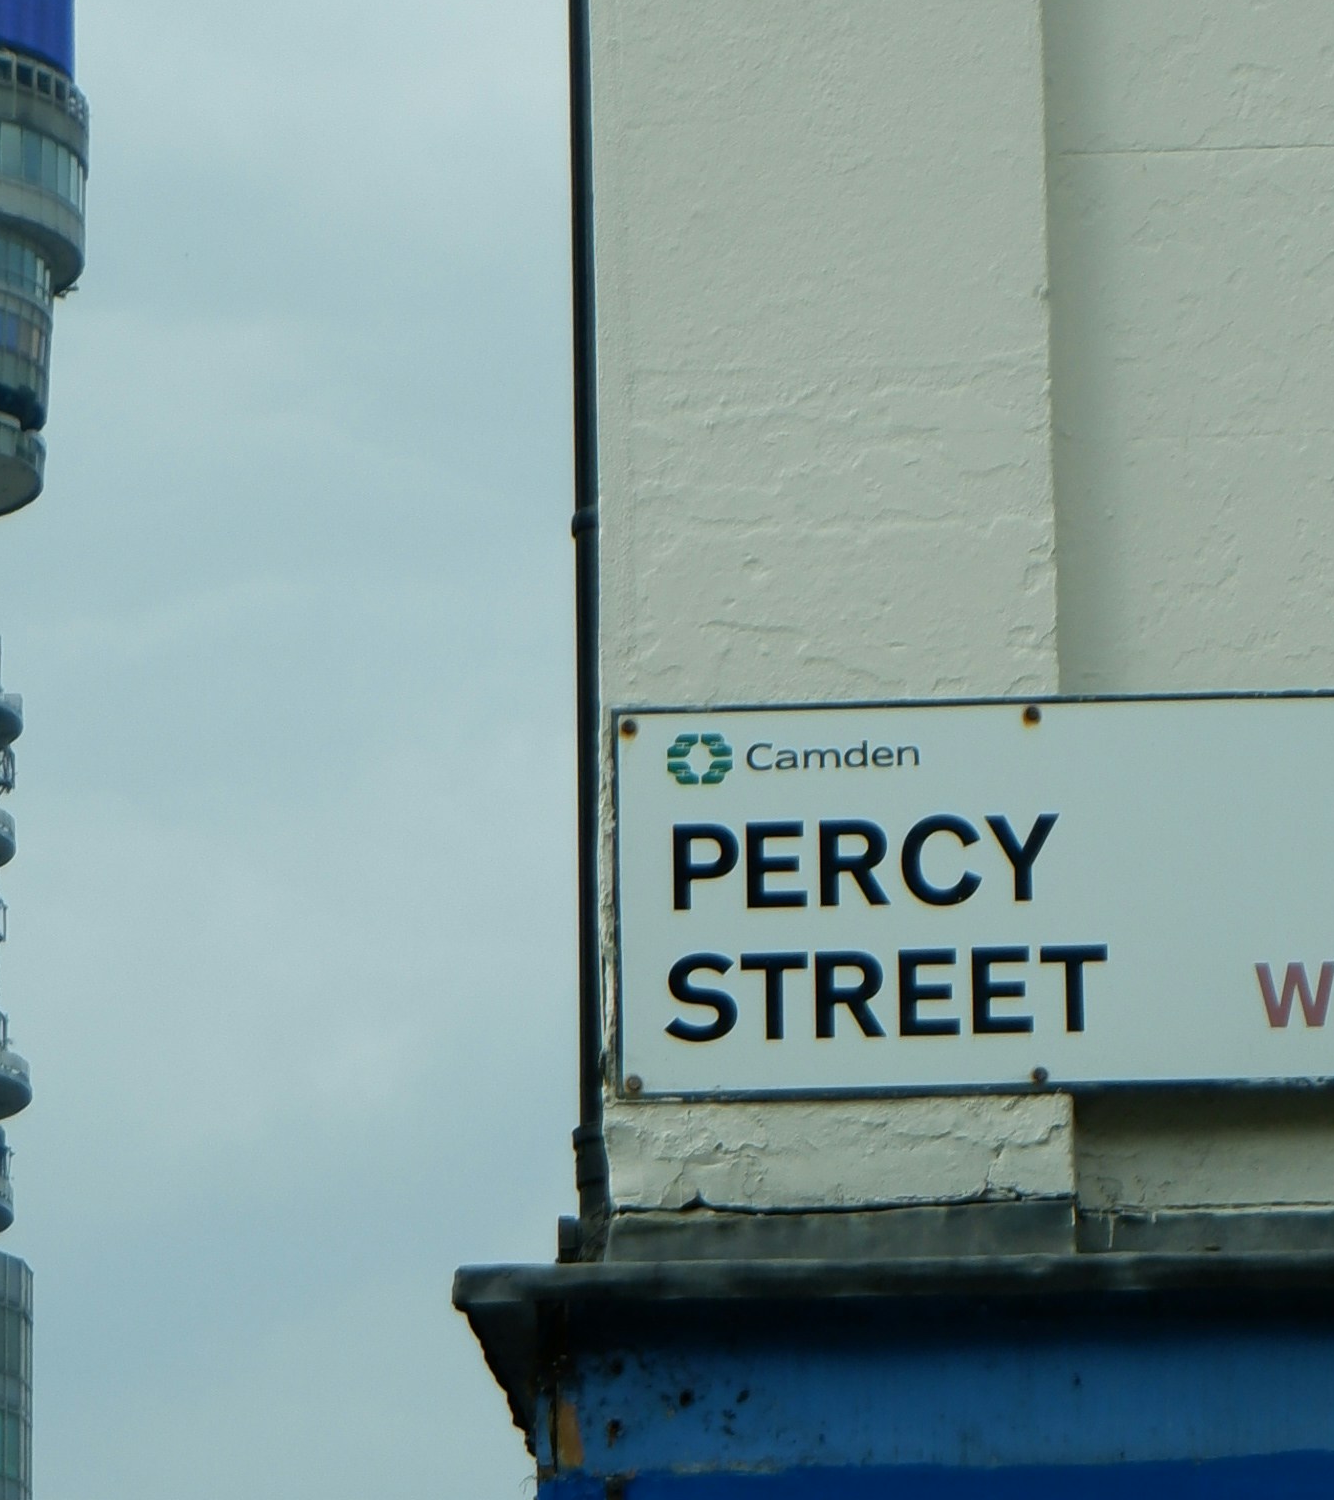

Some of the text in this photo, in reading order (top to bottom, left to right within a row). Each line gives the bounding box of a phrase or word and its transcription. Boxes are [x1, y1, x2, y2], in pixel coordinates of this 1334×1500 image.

[745, 739, 922, 773] Camden
[671, 812, 1060, 911] PERCY
[663, 942, 1109, 1043] STREET
